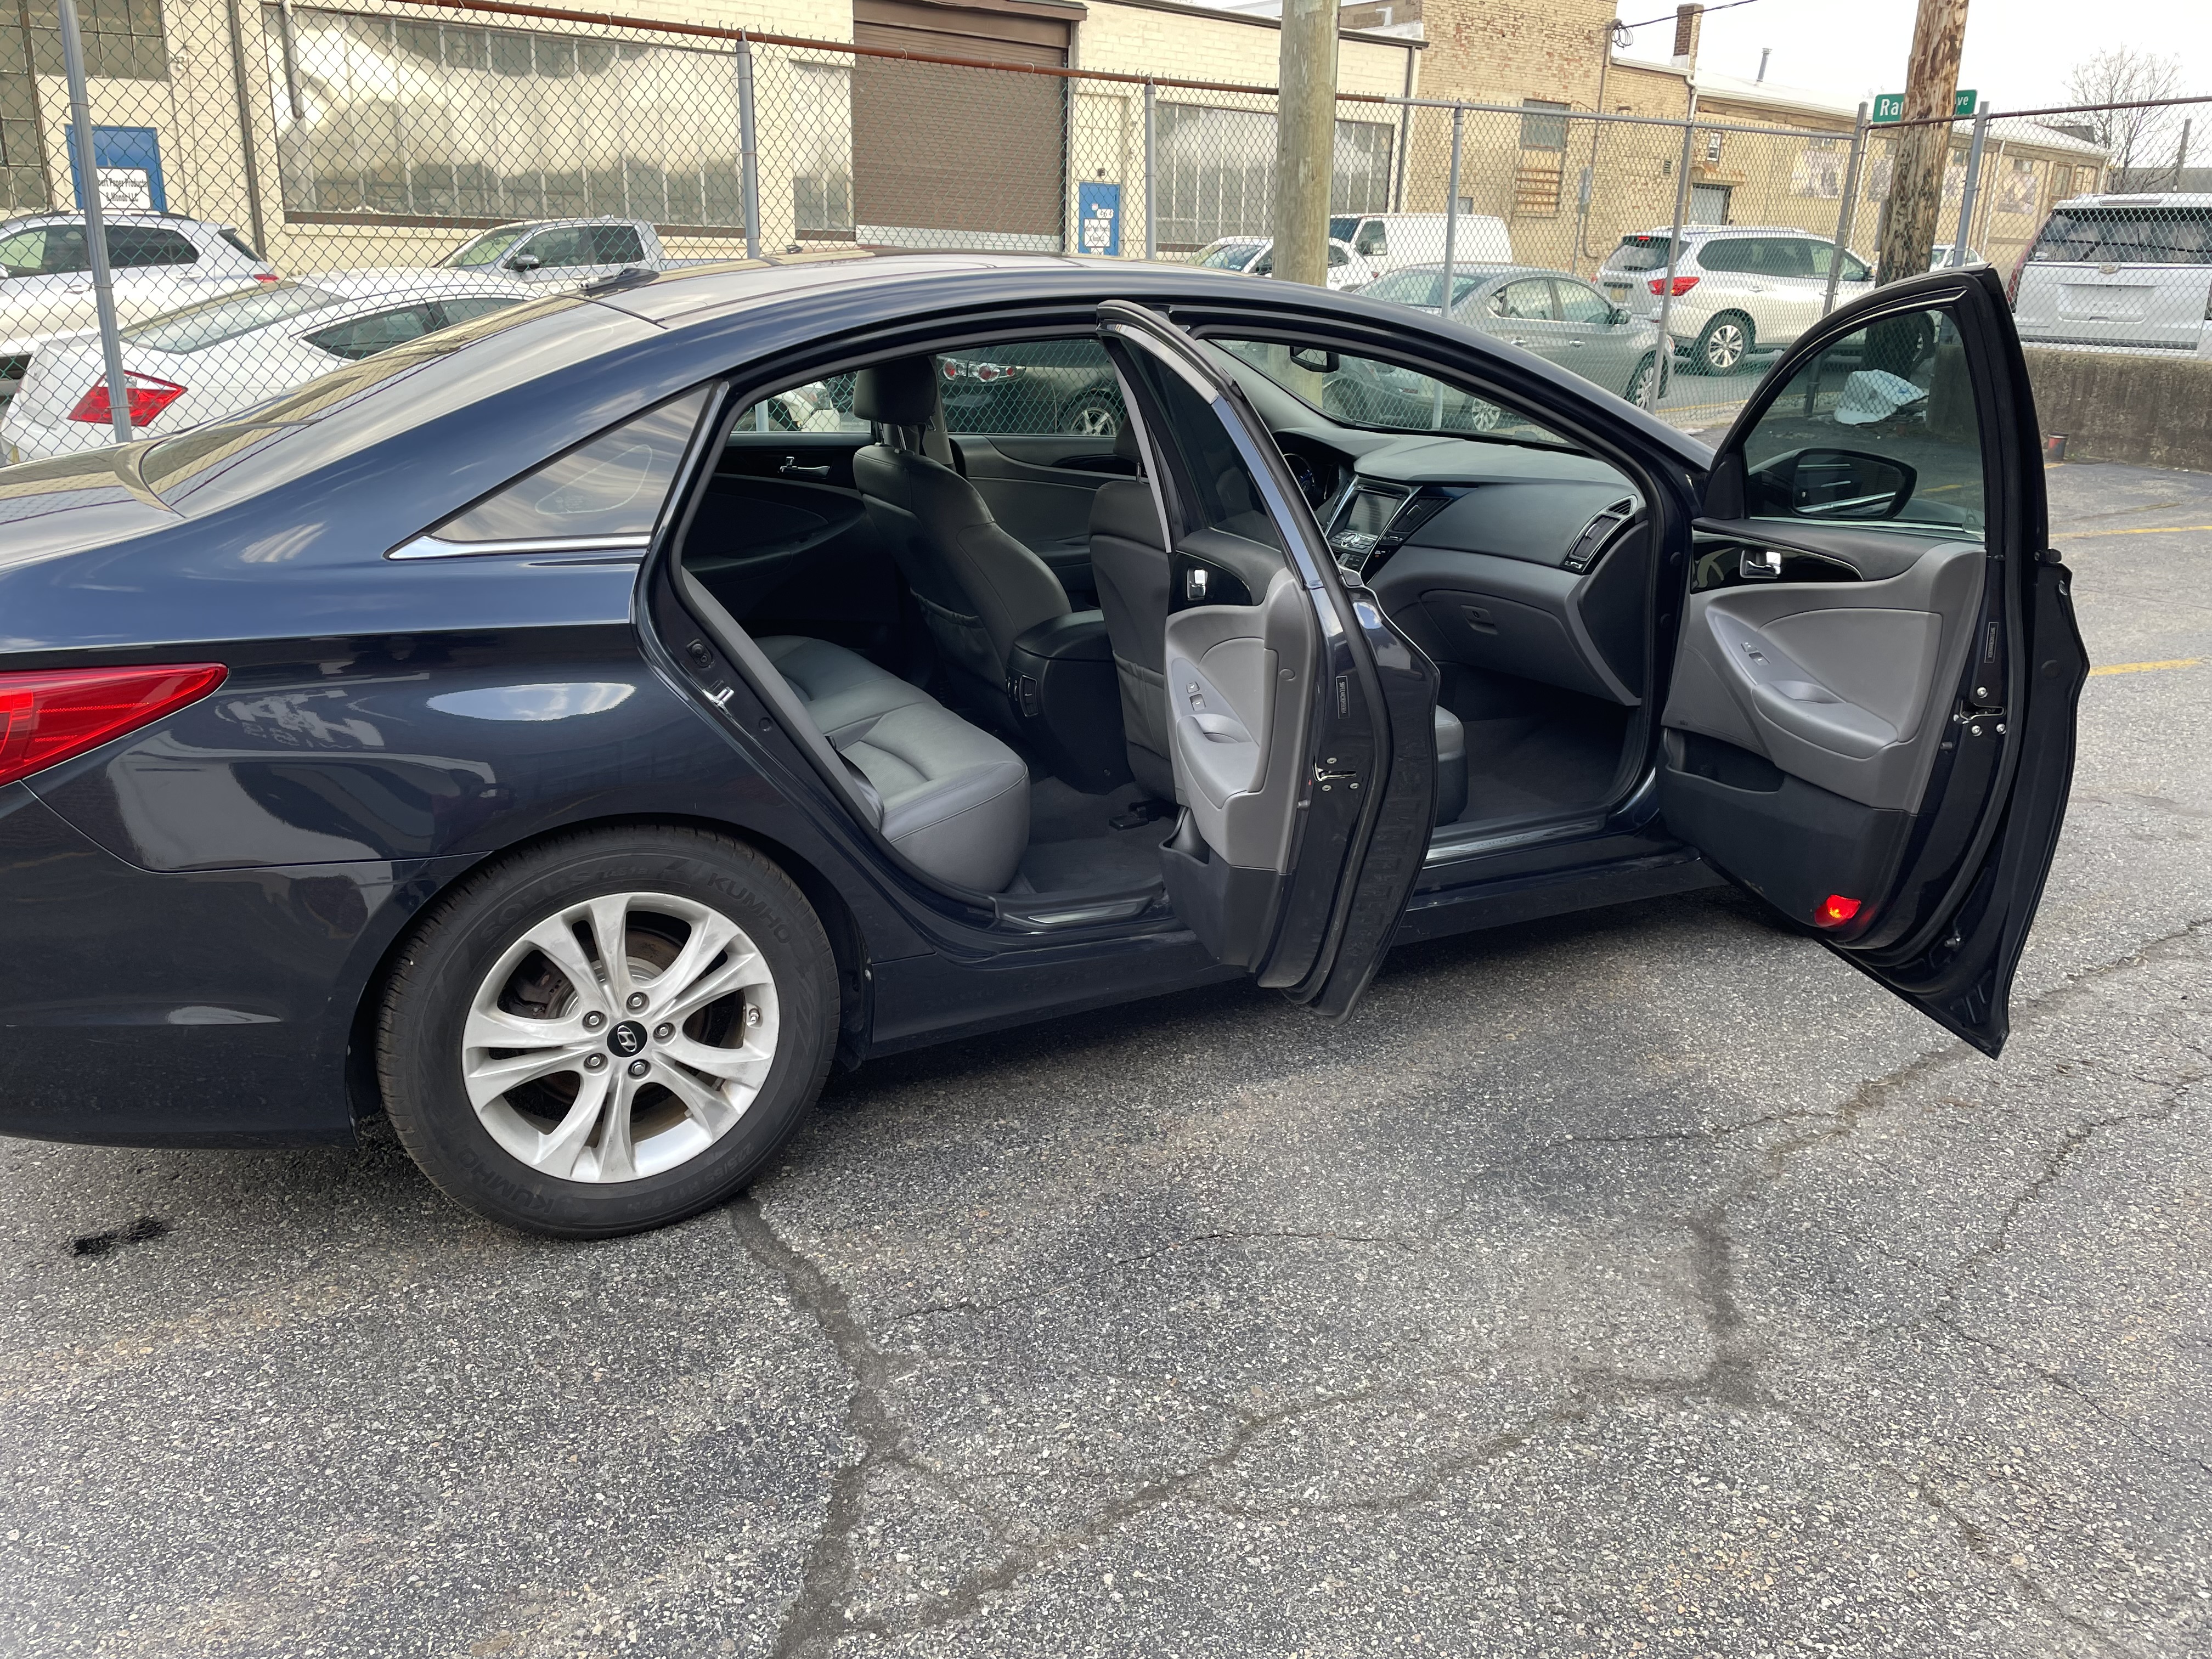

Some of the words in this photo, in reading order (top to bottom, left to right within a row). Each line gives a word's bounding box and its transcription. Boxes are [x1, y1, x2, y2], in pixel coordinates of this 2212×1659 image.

[1955, 96, 1970, 106] ve
[109, 178, 124, 189] Paper
[125, 178, 148, 188] Products
[707, 872, 793, 944] KUMHO
[457, 1147, 555, 1215] KUMHO
[704, 1142, 755, 1186] 225/55
